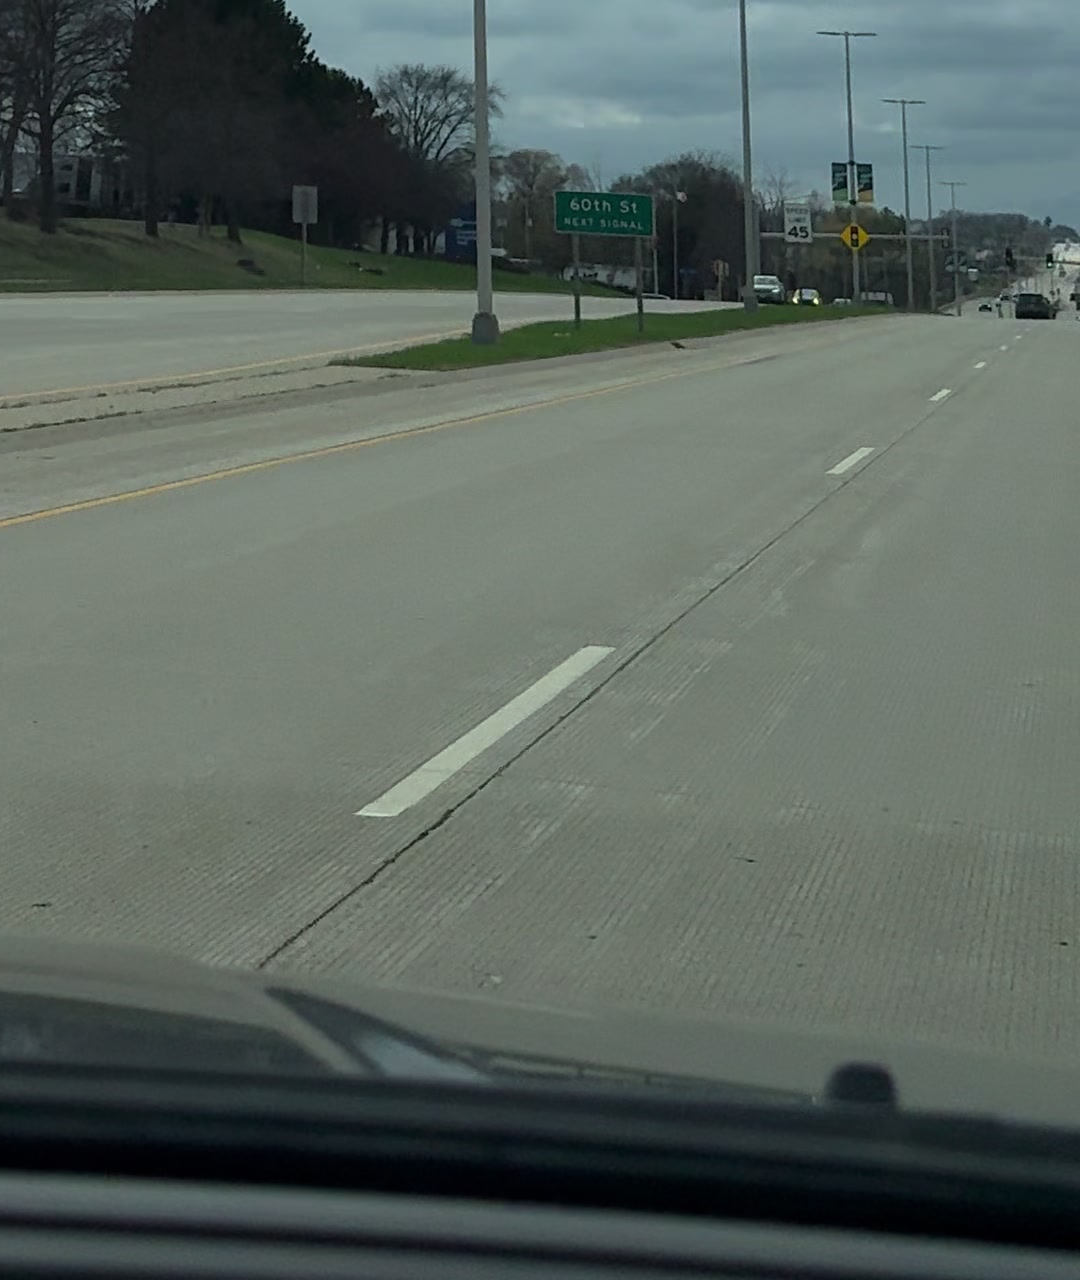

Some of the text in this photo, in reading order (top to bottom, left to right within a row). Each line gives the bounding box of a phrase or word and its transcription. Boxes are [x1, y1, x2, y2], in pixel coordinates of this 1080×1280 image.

[569, 197, 637, 214] 60th St
[563, 217, 644, 231] NEXT SIGNAL
[787, 225, 809, 239] 45
